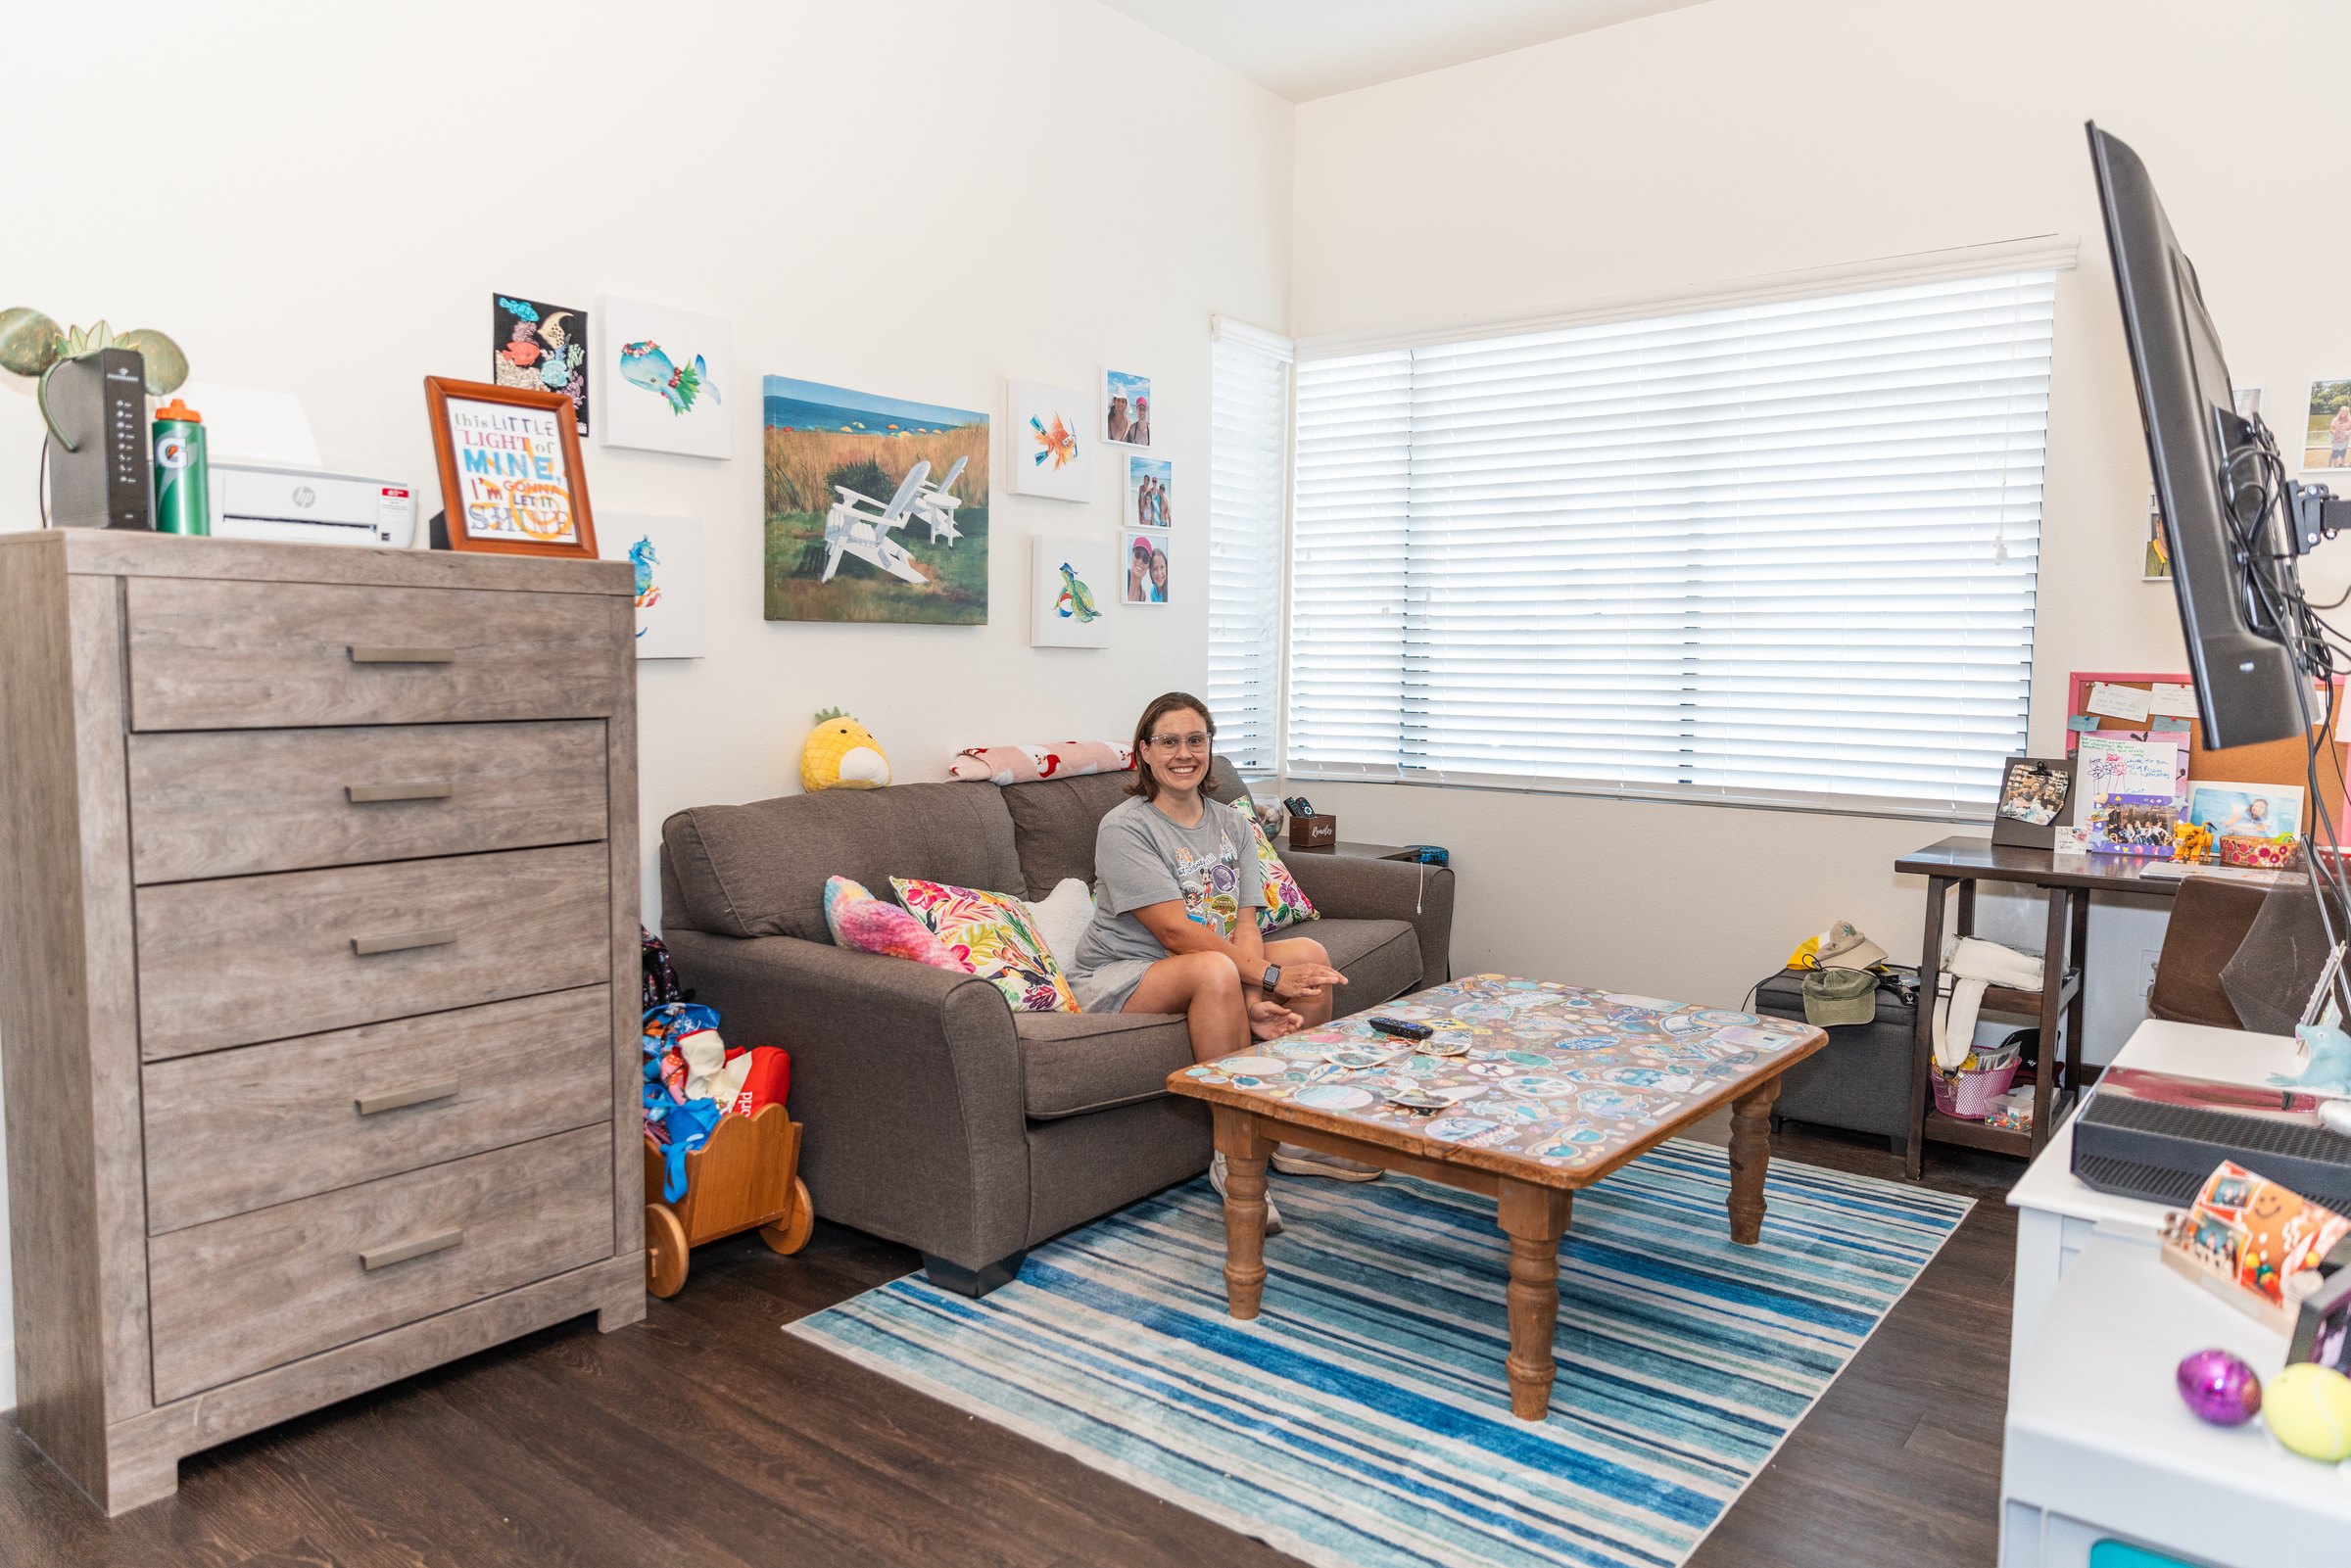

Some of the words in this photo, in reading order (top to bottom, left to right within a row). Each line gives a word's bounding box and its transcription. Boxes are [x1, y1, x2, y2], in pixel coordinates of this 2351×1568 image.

[455, 412, 488, 428] this
[459, 428, 530, 451] LIGHT
[536, 442, 554, 453] of
[157, 438, 188, 469] G
[463, 449, 561, 485] MINE,
[294, 486, 314, 508] hp
[503, 480, 560, 498] GONNA
[513, 495, 536, 506] LET
[541, 497, 553, 508] IT
[468, 504, 573, 536] SHINE
[1312, 825, 1332, 837] Remotes
[739, 1091, 753, 1117] orld
